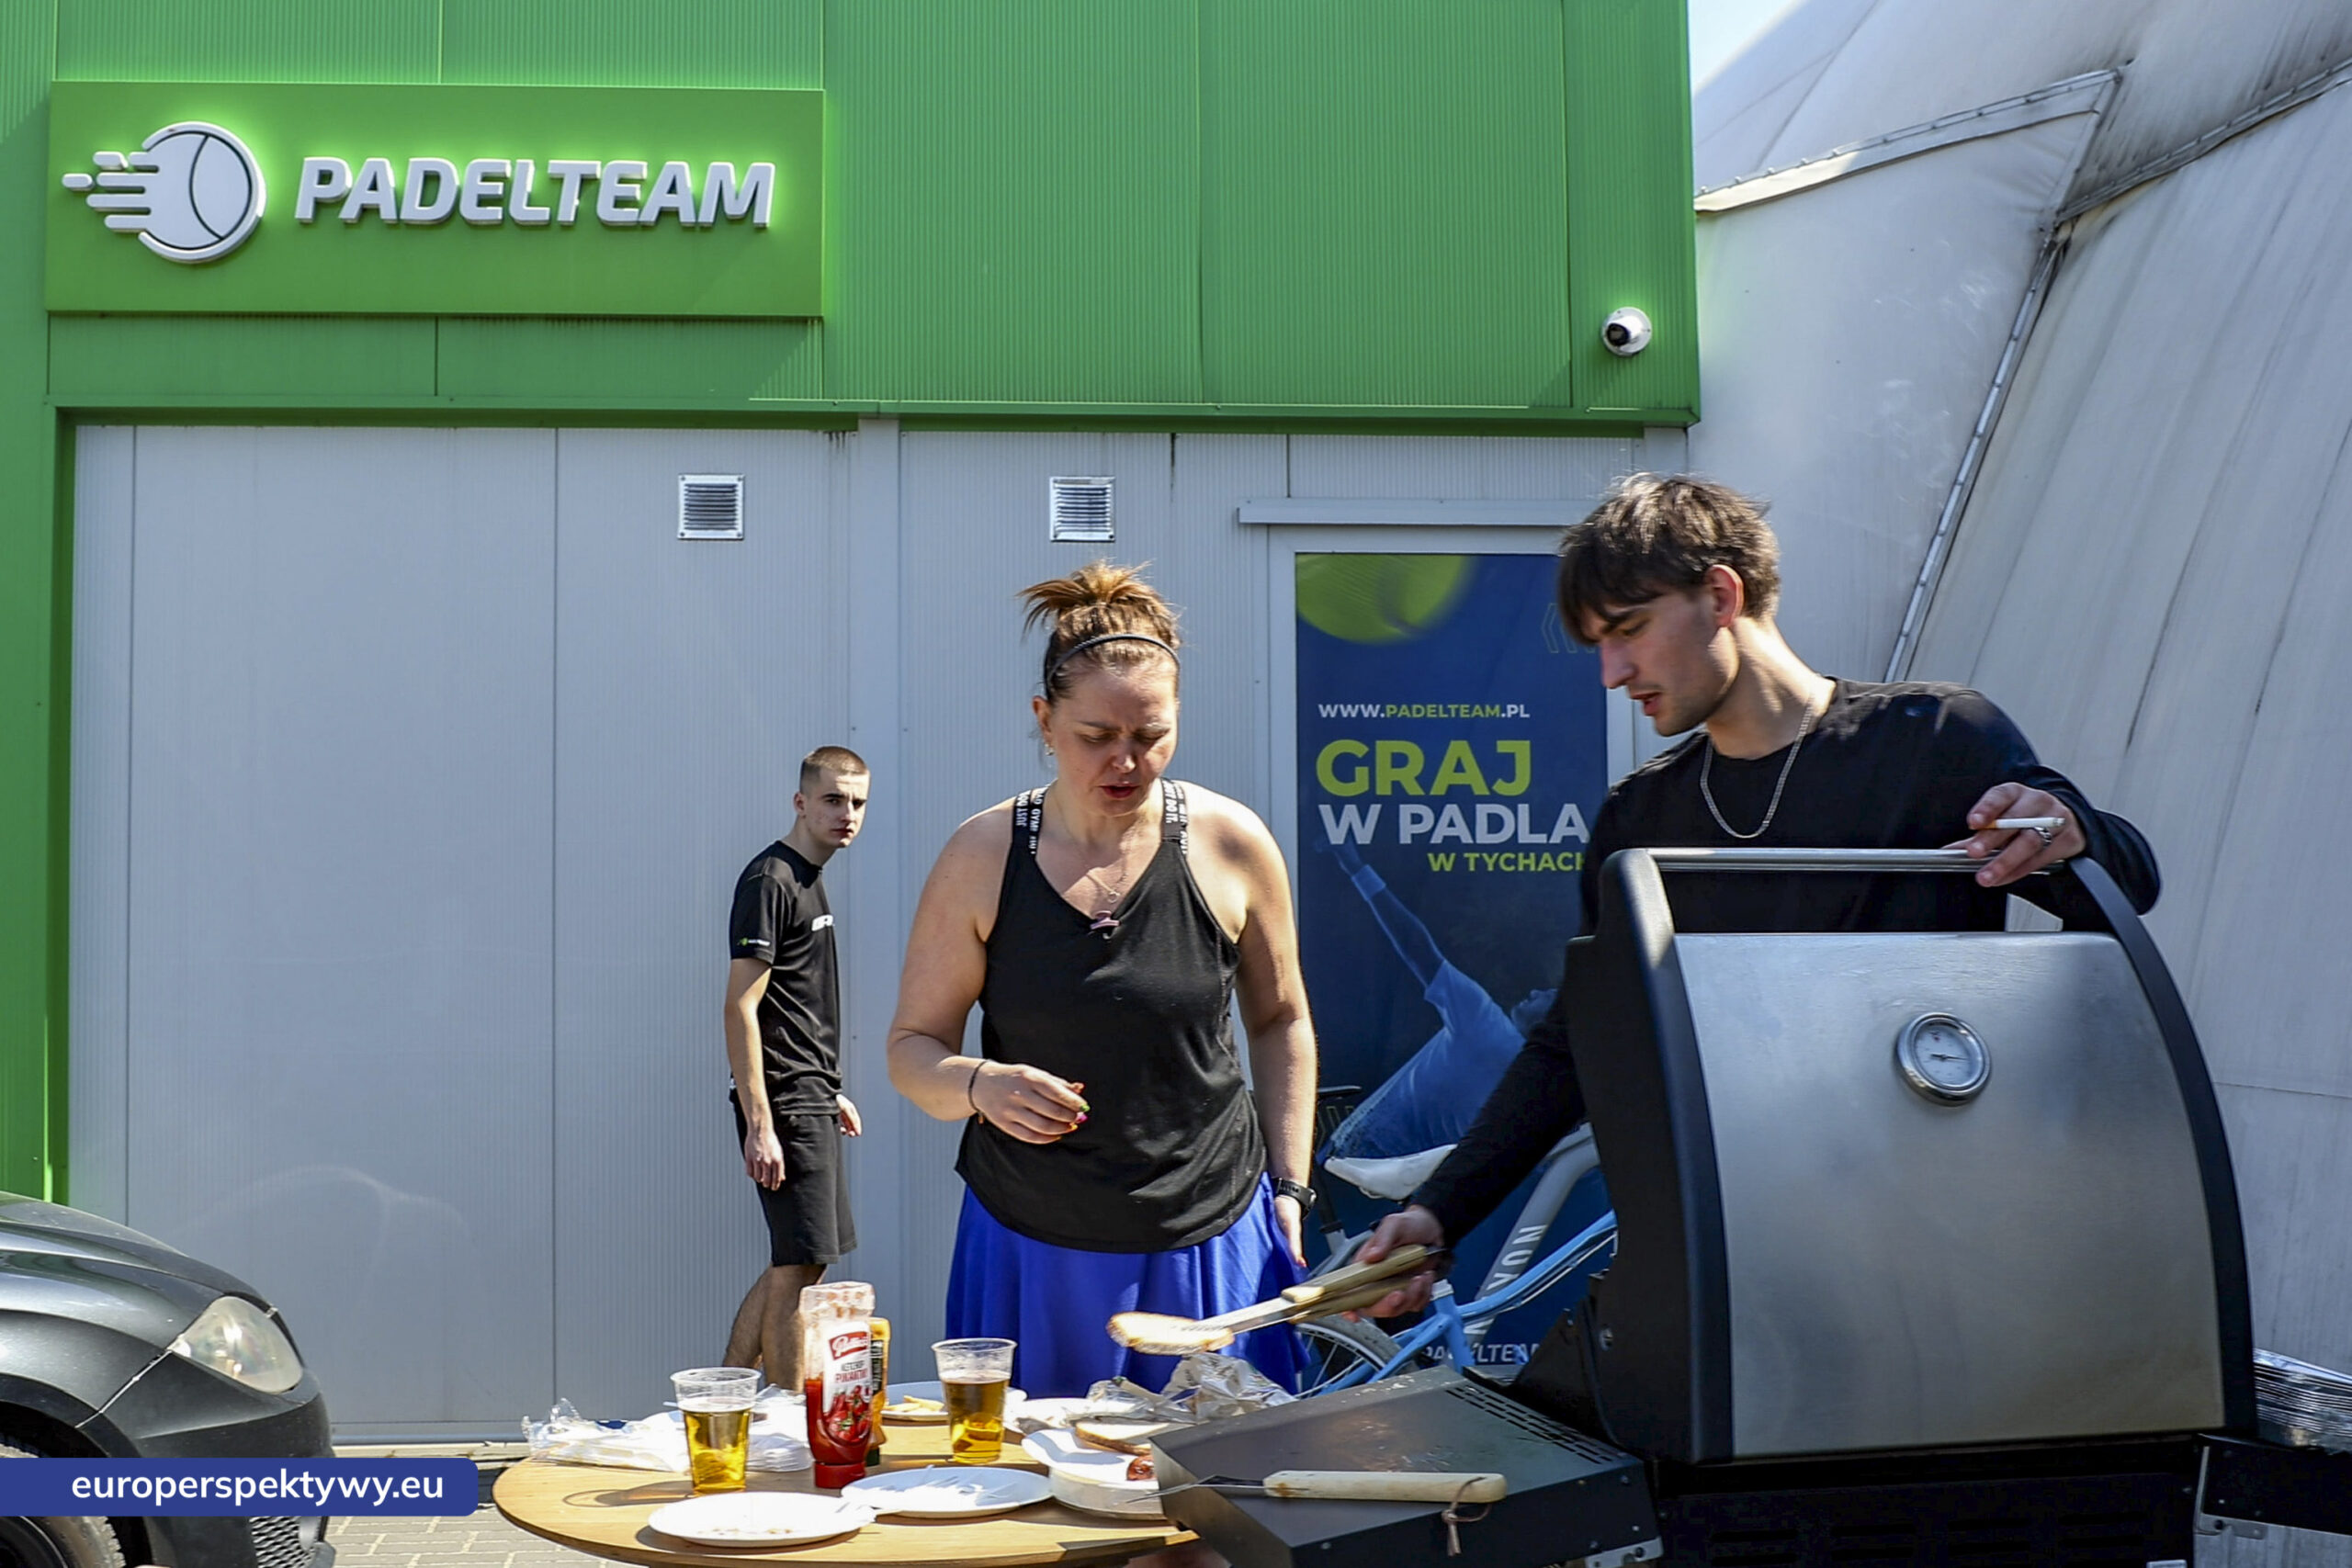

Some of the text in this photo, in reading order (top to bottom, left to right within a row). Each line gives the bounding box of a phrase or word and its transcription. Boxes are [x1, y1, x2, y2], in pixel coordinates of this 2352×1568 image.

[294, 156, 775, 228] PADELTEAM
[1318, 704, 1530, 718] WWW.PADELTEAM.PL
[1316, 739, 1532, 797] GRAJ
[1318, 804, 1589, 845] W PADLA
[1428, 852, 1454, 871] W
